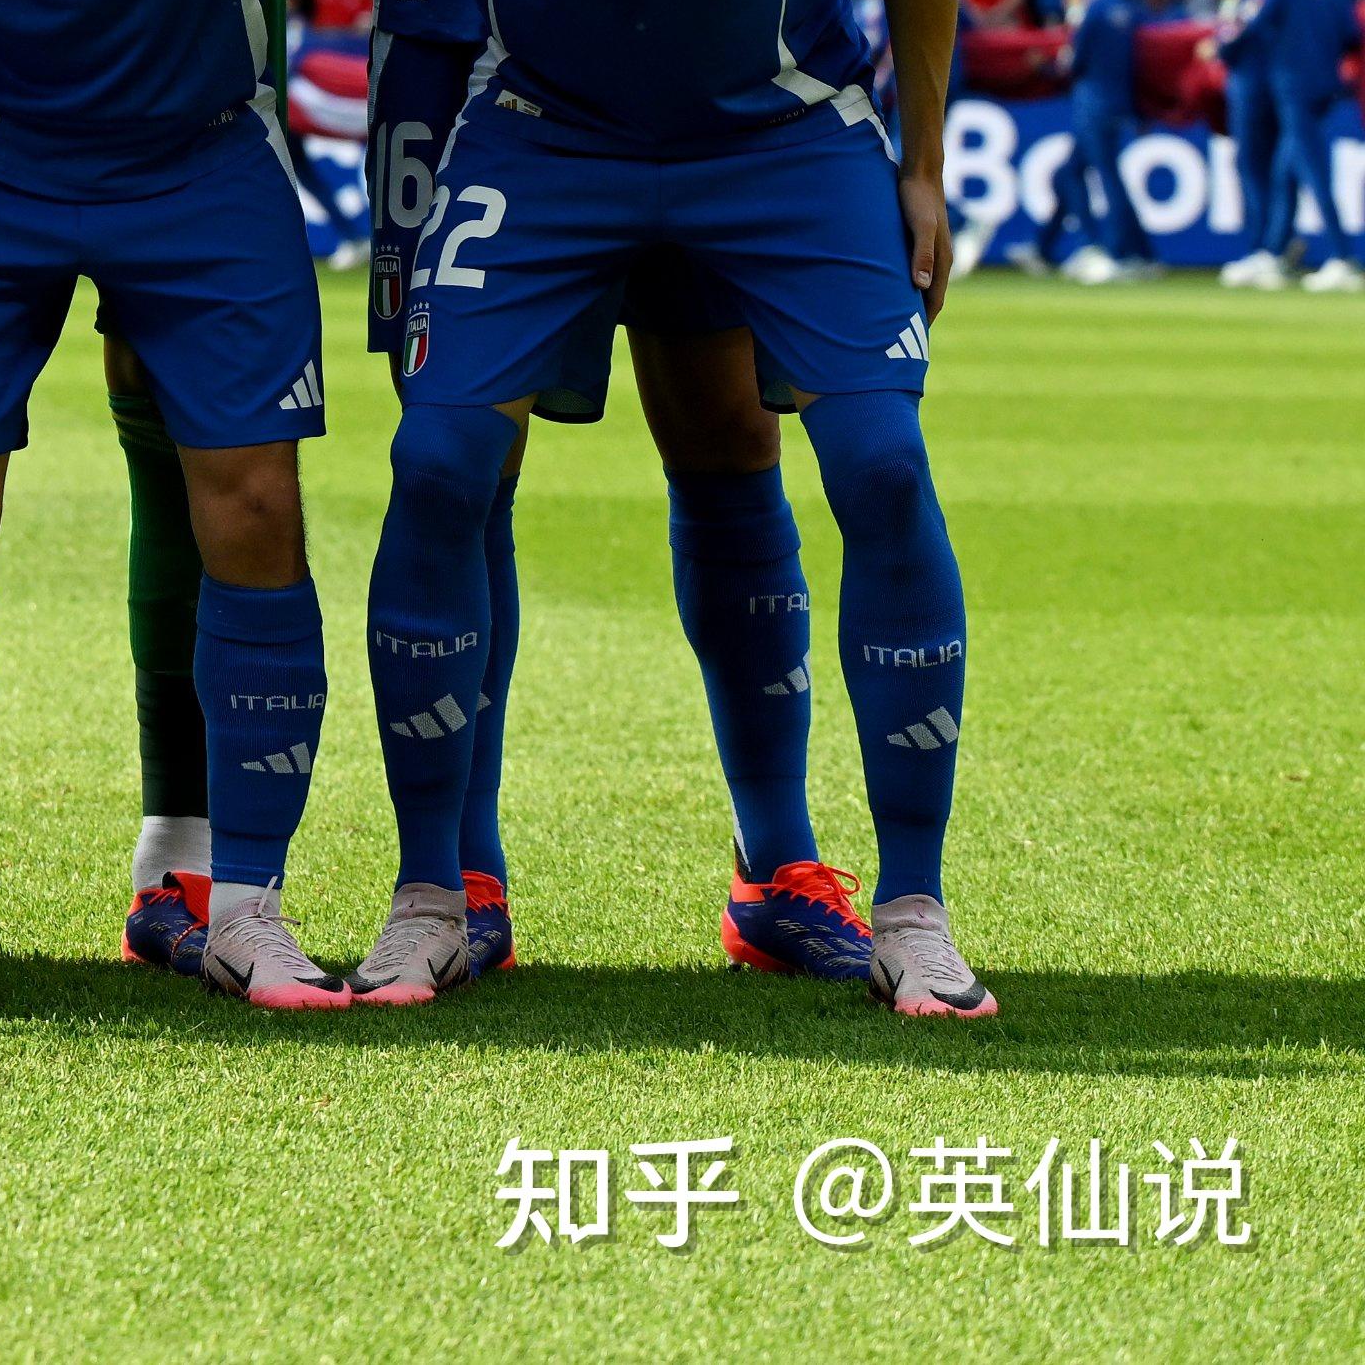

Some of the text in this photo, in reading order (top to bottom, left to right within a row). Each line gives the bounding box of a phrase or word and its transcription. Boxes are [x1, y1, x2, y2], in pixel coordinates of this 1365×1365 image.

[375, 121, 434, 229] 16
[409, 185, 507, 291] 22
[375, 261, 398, 273] ITALIA
[376, 630, 478, 658] ITALIA
[863, 639, 962, 668] ITALIA
[230, 693, 325, 711] ITALIA
